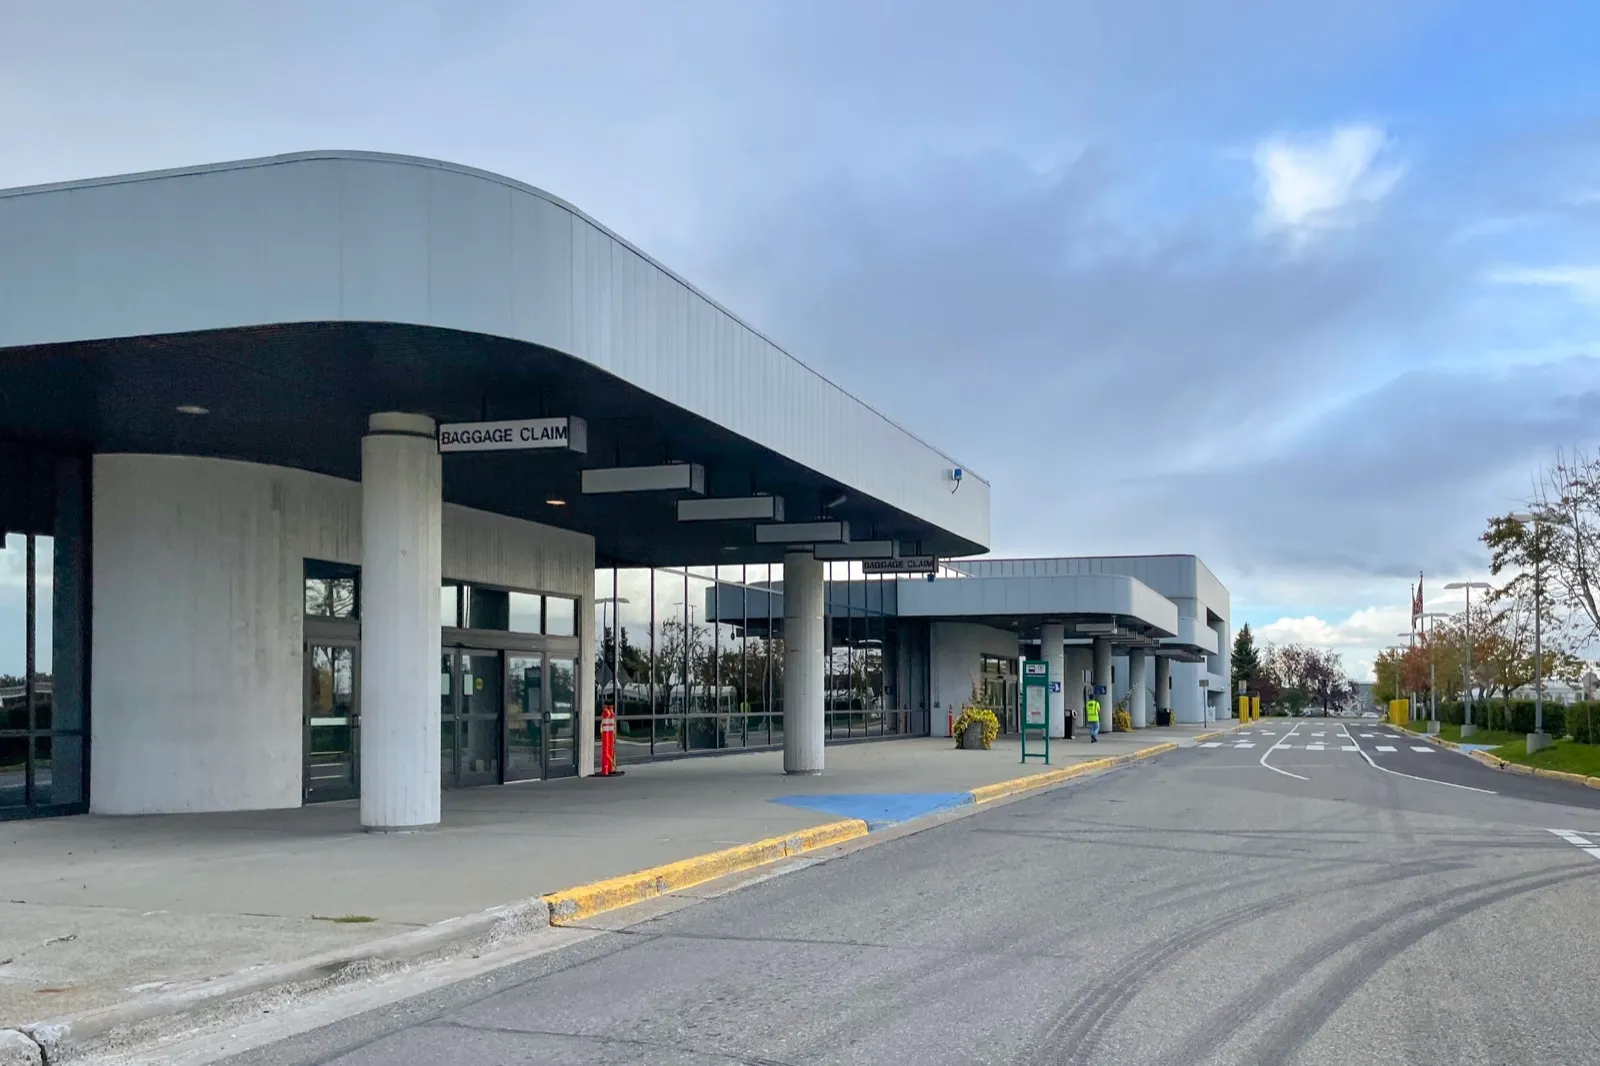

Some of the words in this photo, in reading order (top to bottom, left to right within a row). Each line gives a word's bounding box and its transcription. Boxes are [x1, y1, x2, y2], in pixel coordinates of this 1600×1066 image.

[441, 428, 512, 445] BAGGAGE
[520, 426, 567, 441] CLAIM
[864, 561, 903, 569] BAGGAGE
[907, 560, 933, 568] CLAIM
